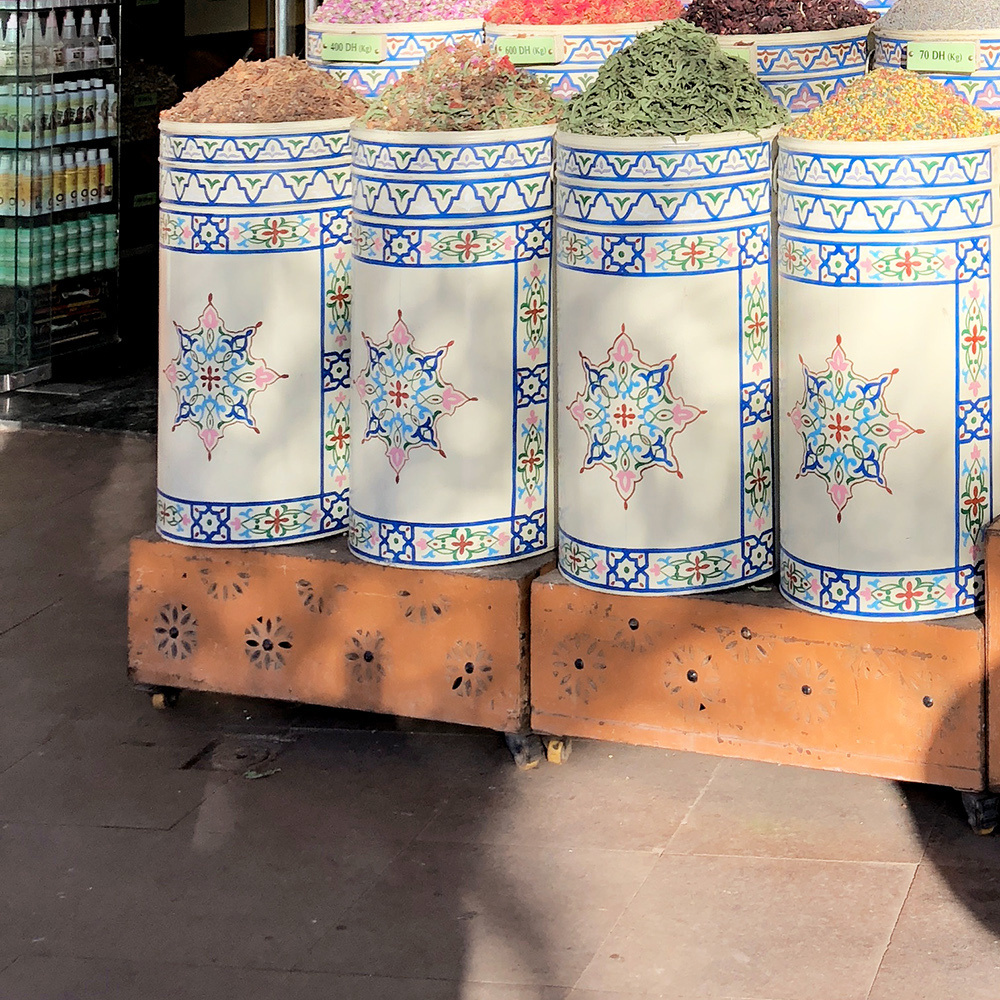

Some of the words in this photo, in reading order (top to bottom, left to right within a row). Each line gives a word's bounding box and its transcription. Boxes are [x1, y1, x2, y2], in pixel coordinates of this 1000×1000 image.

[330, 42, 344, 52] 400
[345, 43, 357, 52] DH
[505, 45, 517, 55] 600
[519, 45, 531, 55] DH
[919, 49, 930, 60] 70
[932, 50, 945, 60] DH
[947, 52, 963, 63] (Kg)
